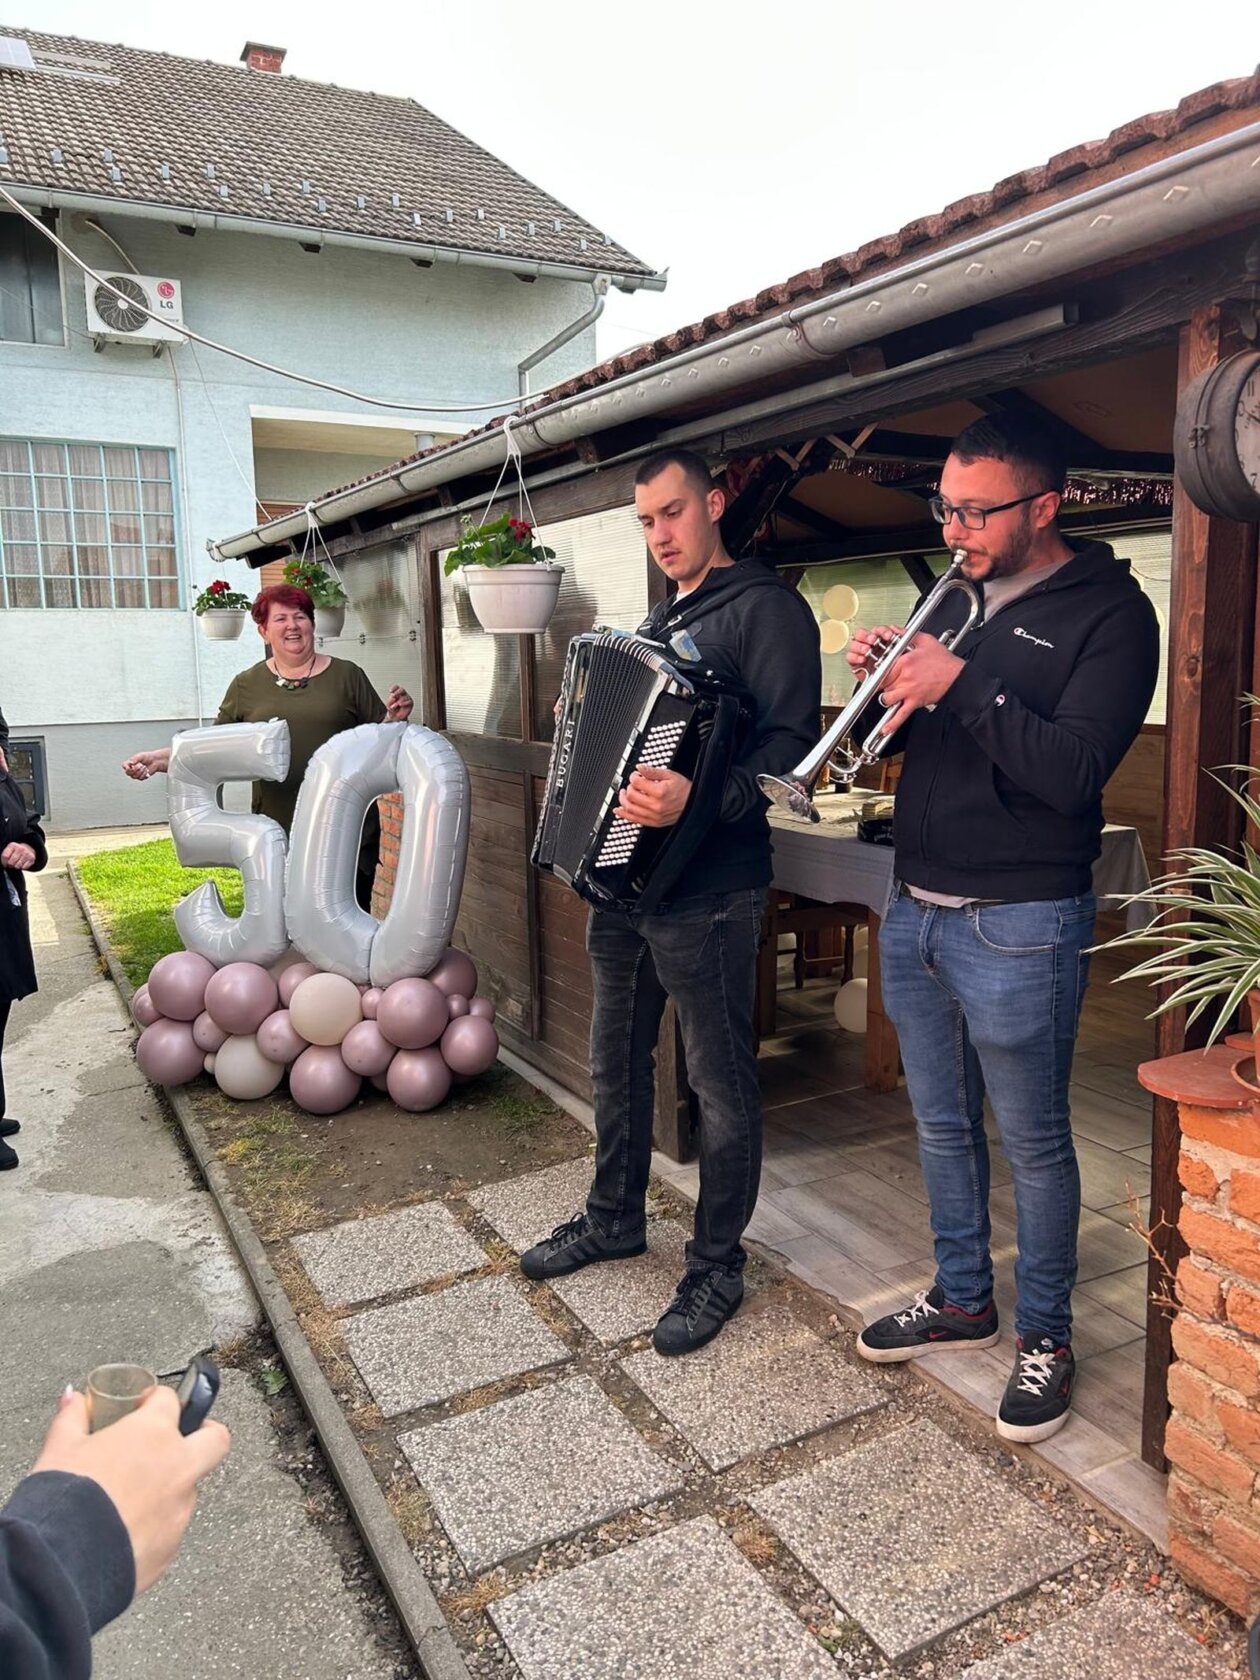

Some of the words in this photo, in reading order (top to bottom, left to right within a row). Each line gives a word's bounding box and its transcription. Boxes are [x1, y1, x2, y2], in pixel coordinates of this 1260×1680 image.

[160, 300, 174, 309] LG
[1013, 626, 1055, 649] Champion
[556, 718, 576, 788] BUGARI
[166, 718, 471, 988] 50
